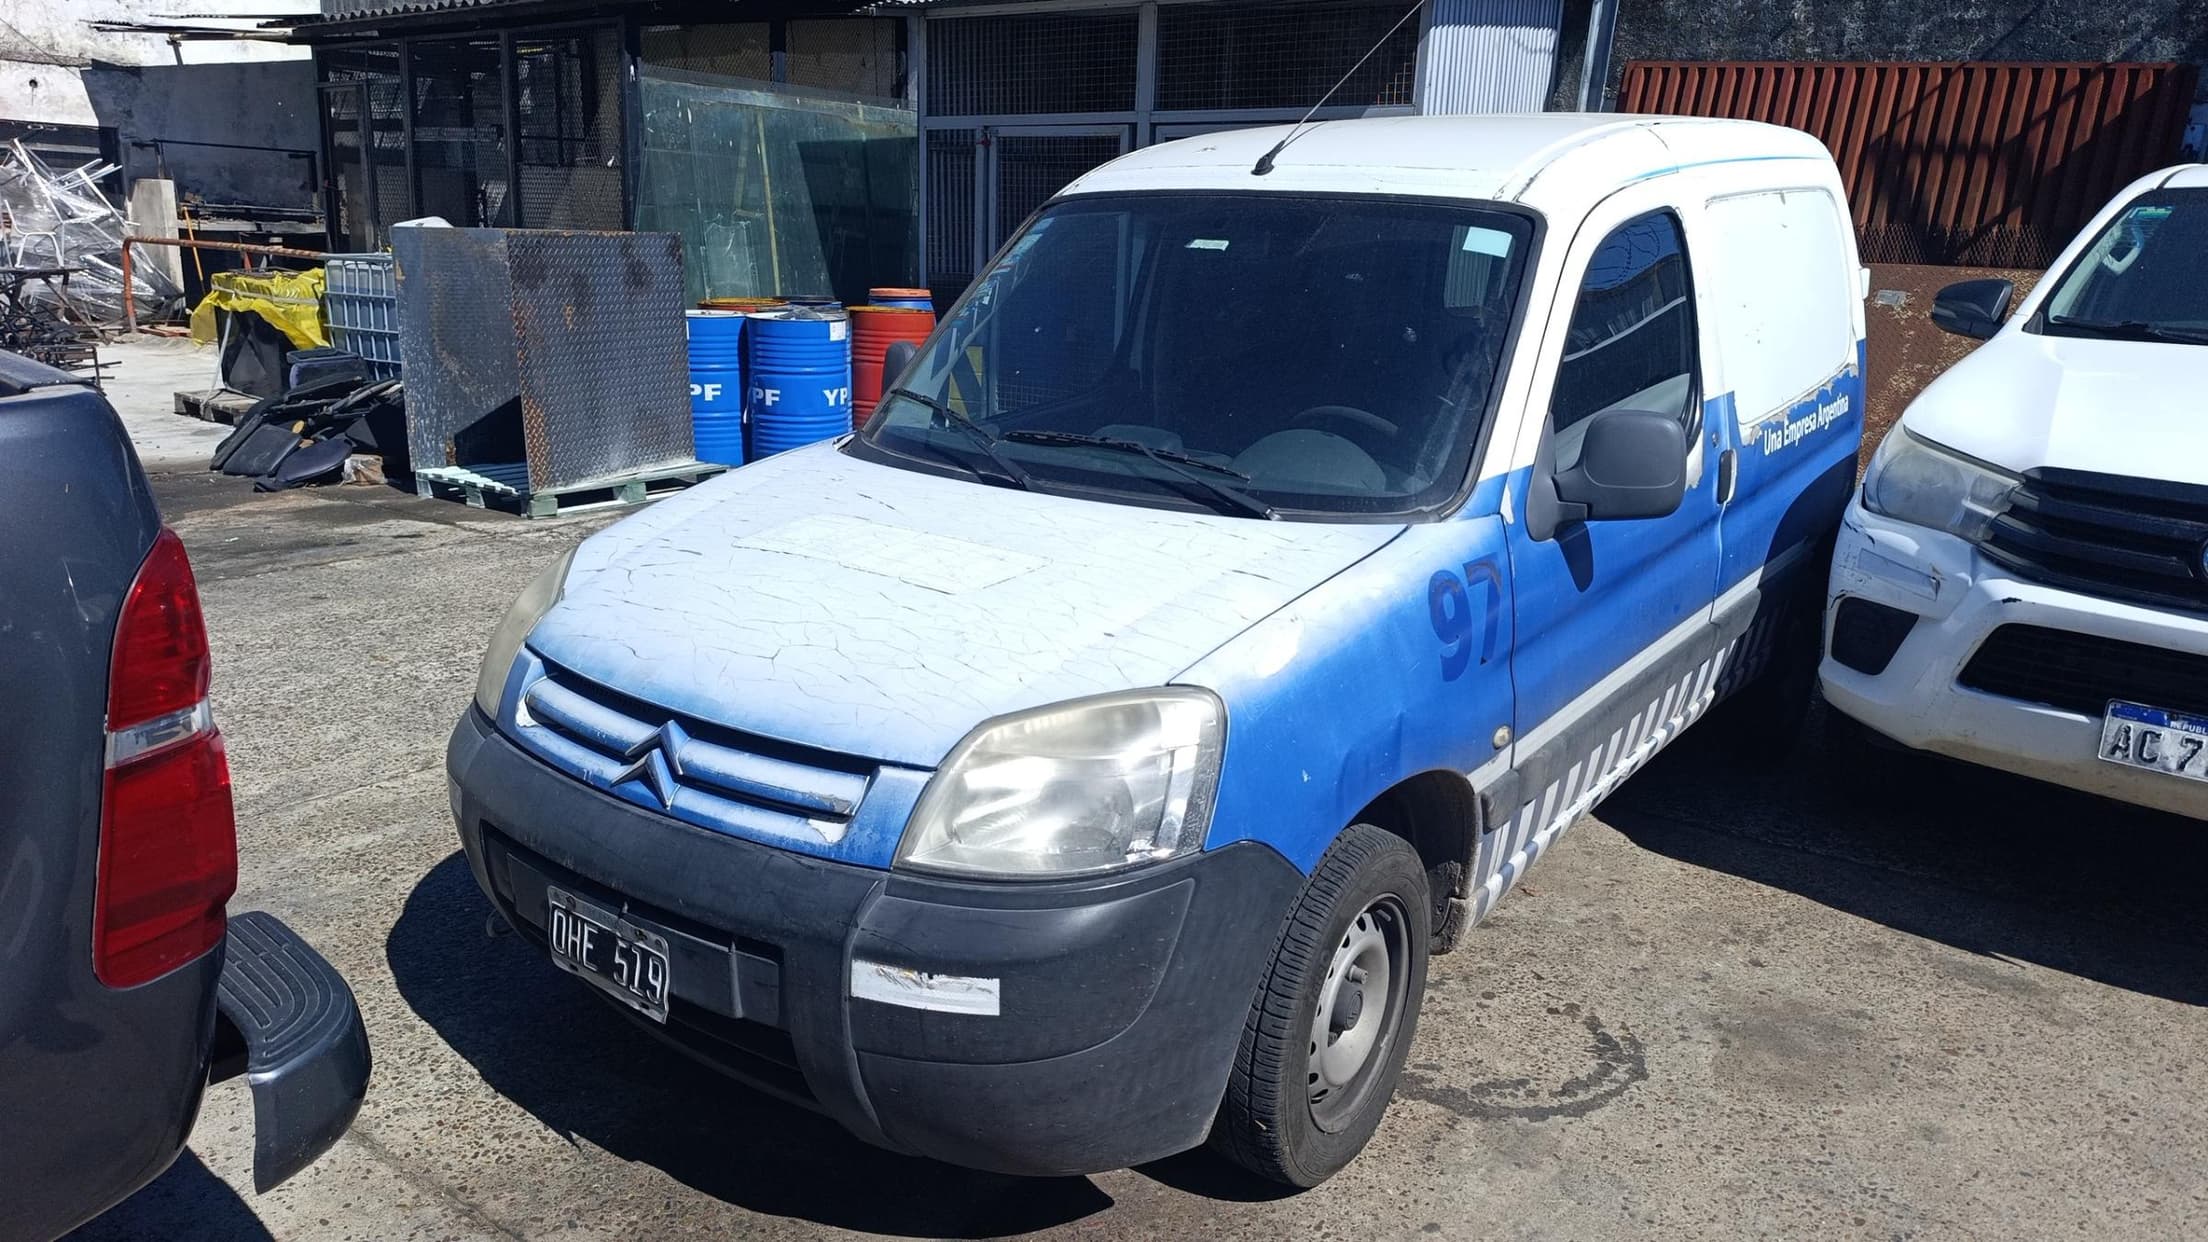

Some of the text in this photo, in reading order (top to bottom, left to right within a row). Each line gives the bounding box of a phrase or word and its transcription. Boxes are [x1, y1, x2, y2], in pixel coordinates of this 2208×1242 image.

[1764, 392, 1849, 456] Una Empresa Argentina
[1428, 551, 1502, 683] 97
[2109, 723, 2208, 778] AC 7
[552, 909, 662, 1004] OHE 519
